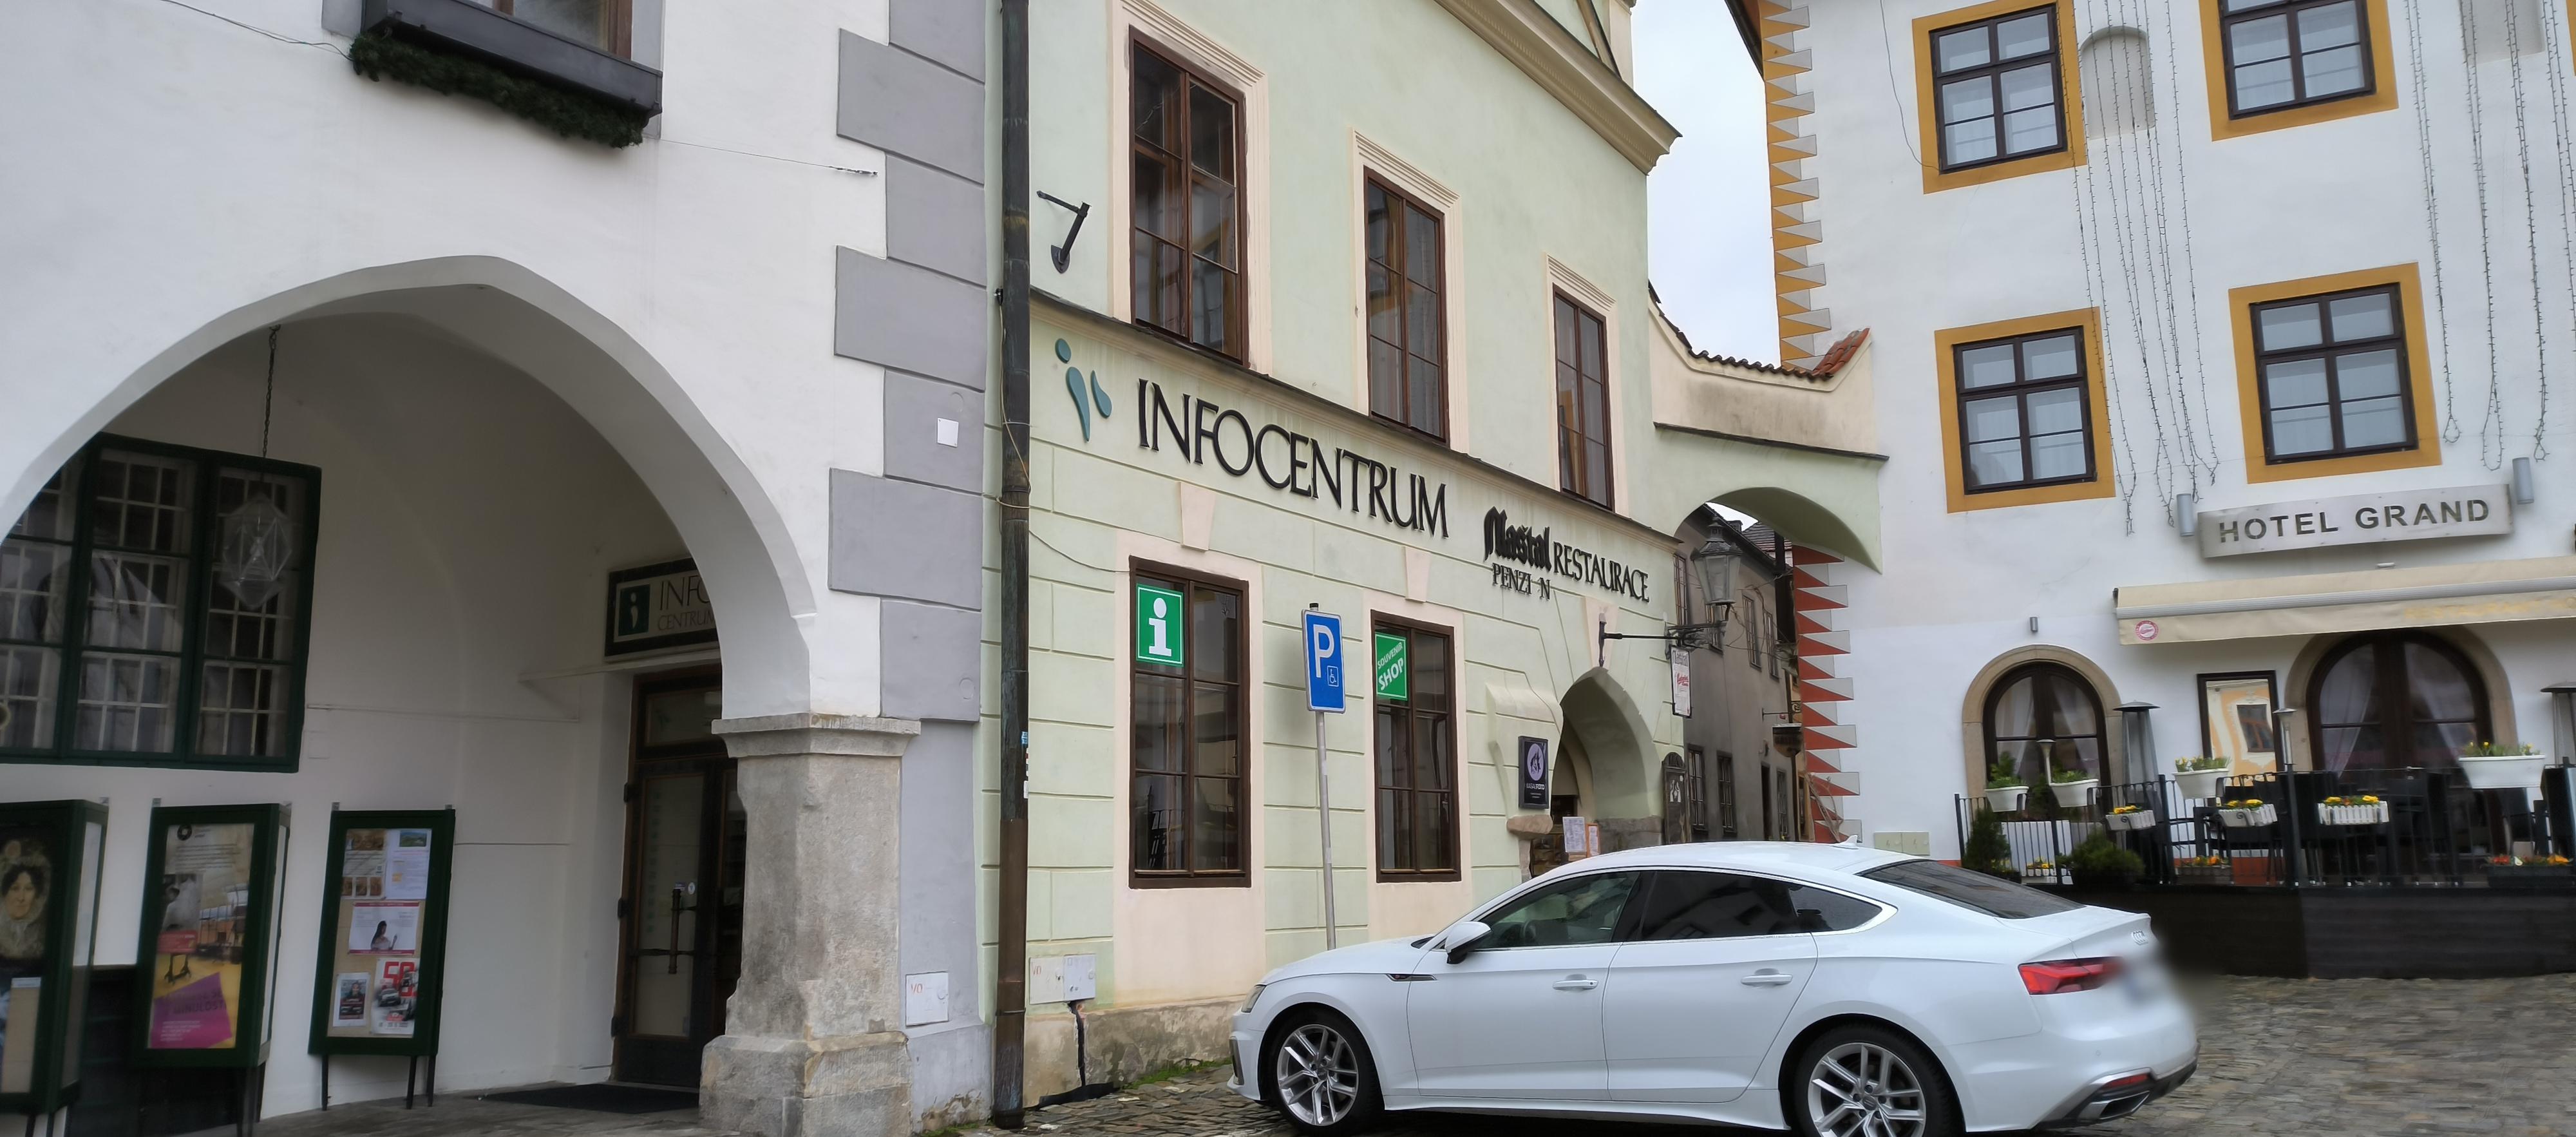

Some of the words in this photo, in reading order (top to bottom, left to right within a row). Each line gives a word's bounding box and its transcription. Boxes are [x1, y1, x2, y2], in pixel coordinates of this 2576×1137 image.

[1139, 377, 1449, 539] INFOCENTRUM
[2219, 511, 2339, 543] HOTEL
[2355, 499, 2490, 529] GRAND
[1553, 541, 1650, 603] RESTAURACE
[1313, 624, 1335, 678] P
[1377, 642, 1403, 670] SOUVENIR
[1378, 657, 1404, 691] SHOP
